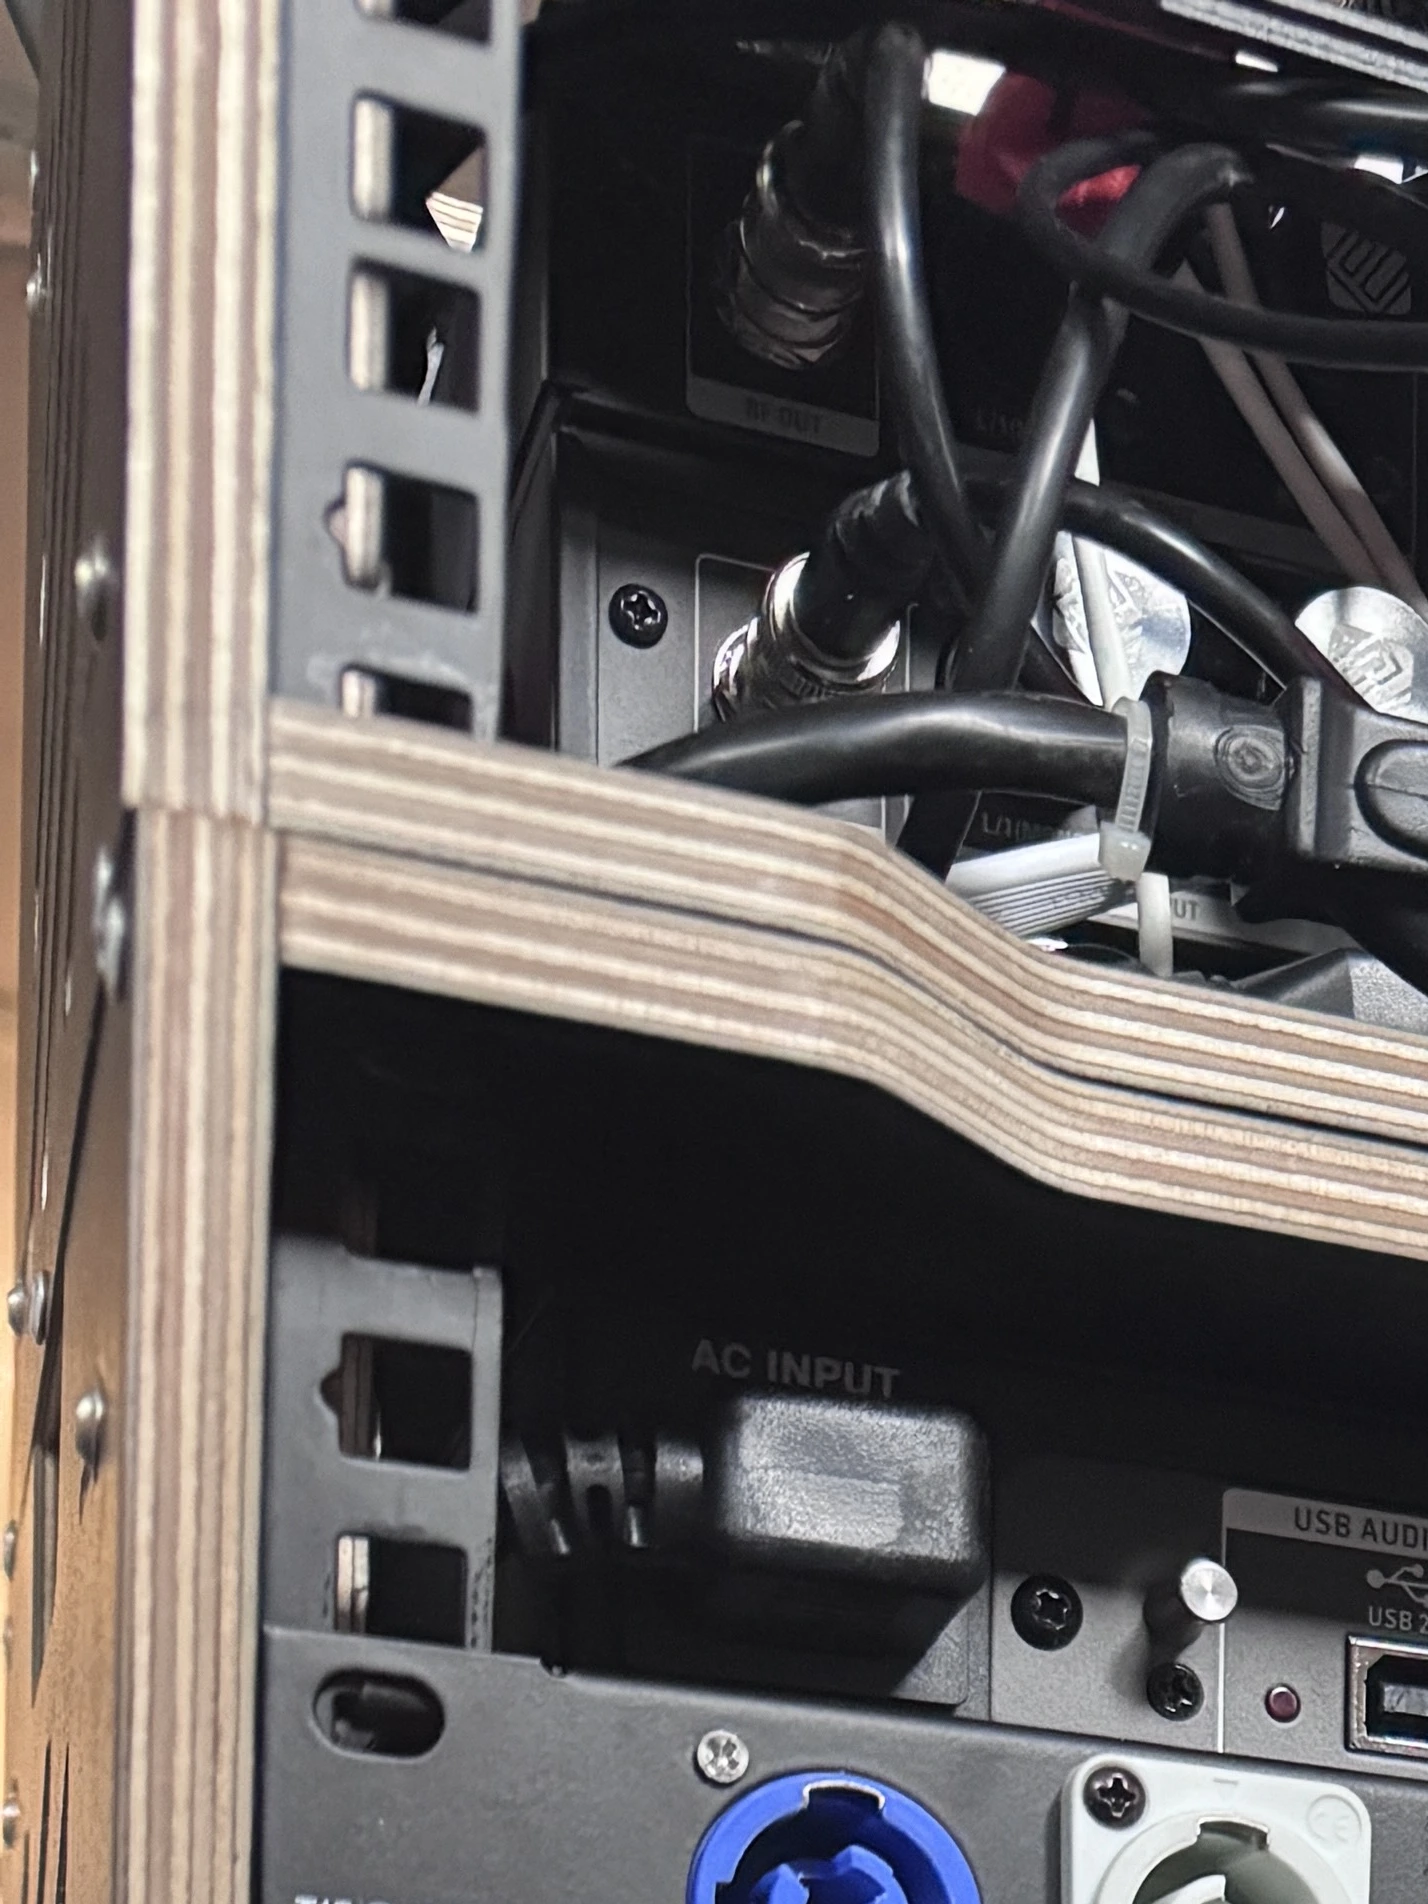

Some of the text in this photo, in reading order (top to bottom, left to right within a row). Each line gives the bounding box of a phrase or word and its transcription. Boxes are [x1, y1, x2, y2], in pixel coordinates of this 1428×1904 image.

[691, 1337, 902, 1401] AC INPUT
[1293, 1504, 1352, 1541] USB
[1366, 1604, 1413, 1634] USB
